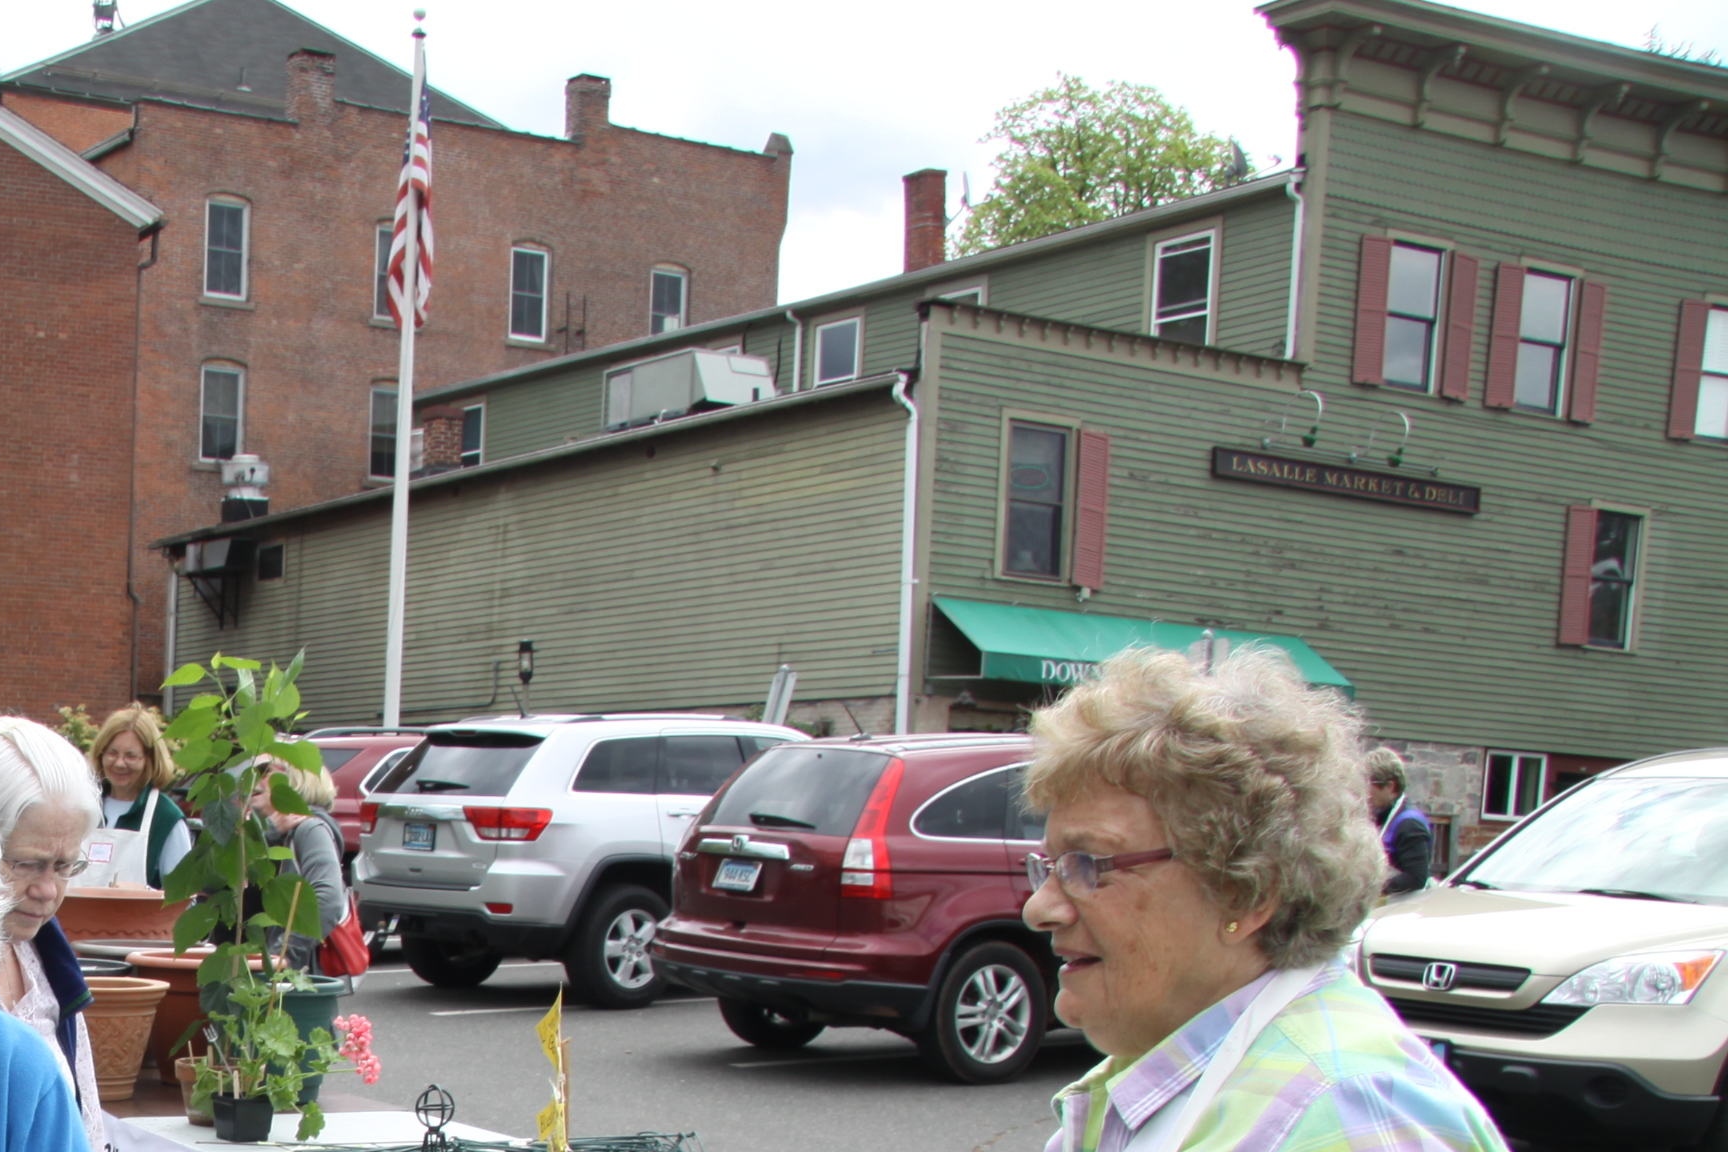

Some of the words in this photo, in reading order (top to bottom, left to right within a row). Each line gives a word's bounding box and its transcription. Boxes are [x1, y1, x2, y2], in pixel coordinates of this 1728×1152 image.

[1231, 455, 1317, 483] LASALLE
[1324, 471, 1403, 497] MARKET
[1407, 483, 1421, 499] &
[1424, 487, 1466, 505] DELI
